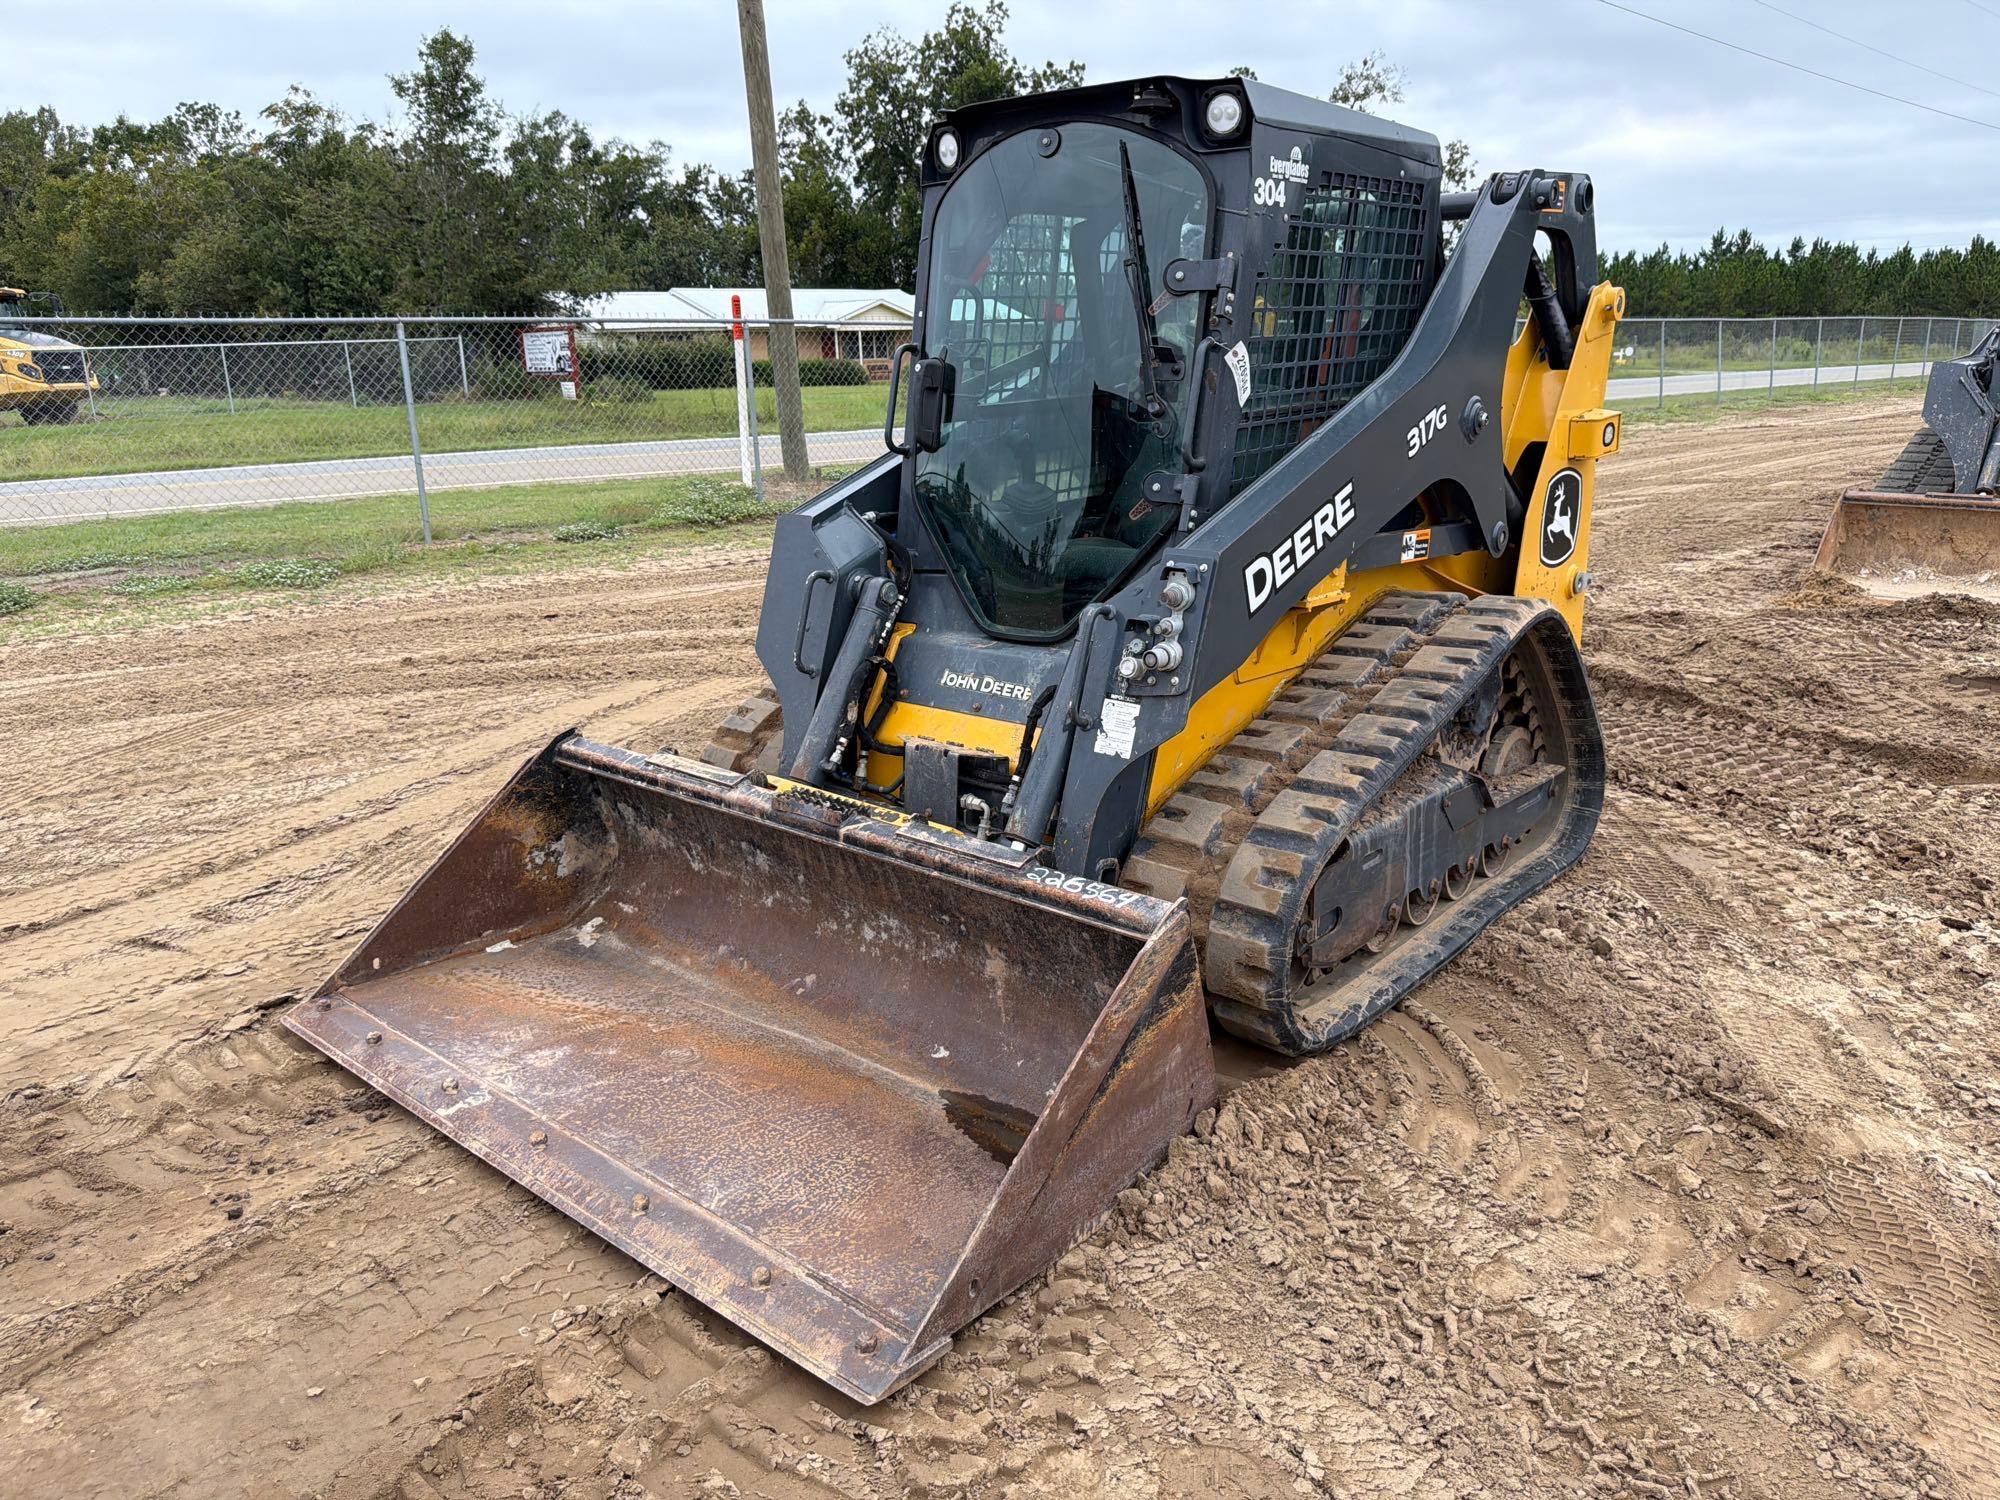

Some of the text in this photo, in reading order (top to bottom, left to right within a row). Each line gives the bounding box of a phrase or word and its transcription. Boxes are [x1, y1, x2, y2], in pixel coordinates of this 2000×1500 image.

[1270, 155, 1309, 179] Everglades
[1253, 177, 1286, 208] 304
[1407, 404, 1447, 458] 317G
[1244, 481, 1356, 614] DEERE
[940, 669, 1032, 700] JOHN DEERE
[1026, 867, 1140, 908] 226564
